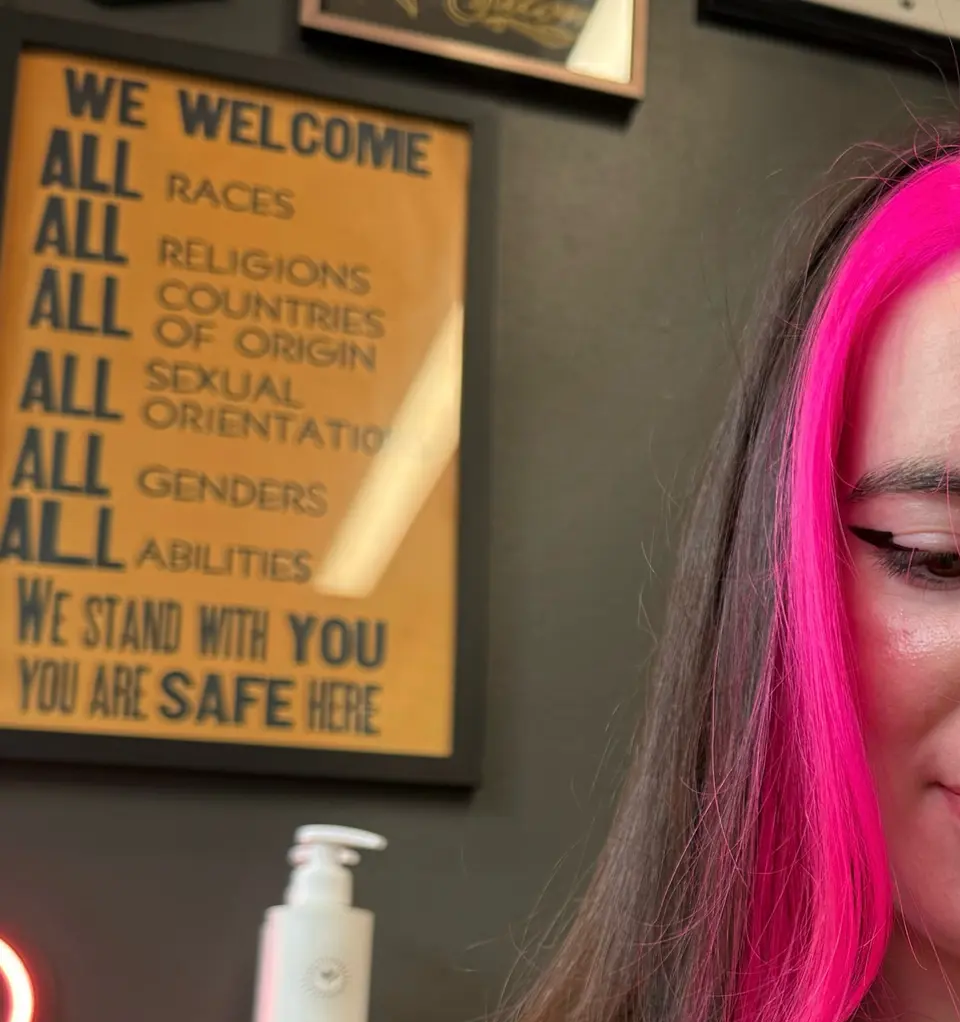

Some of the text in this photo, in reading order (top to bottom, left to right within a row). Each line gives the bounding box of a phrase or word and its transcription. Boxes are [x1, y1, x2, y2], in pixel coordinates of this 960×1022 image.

[65, 68, 432, 178] WE WELCOME
[41, 128, 296, 221] ALL RACES
[34, 196, 371, 294] ALL RELIGIONS
[28, 267, 386, 339] ALL COUNTRIES
[153, 316, 378, 371] OF ORIGIN
[19, 349, 305, 421] ALL SEXUAL
[10, 426, 328, 517] ALL GENDERS
[0, 497, 313, 583] ALL ABILITIES
[17, 576, 388, 669] WE STAND WITH YOU
[18, 658, 382, 735] YOU ARE SAFE HERE
